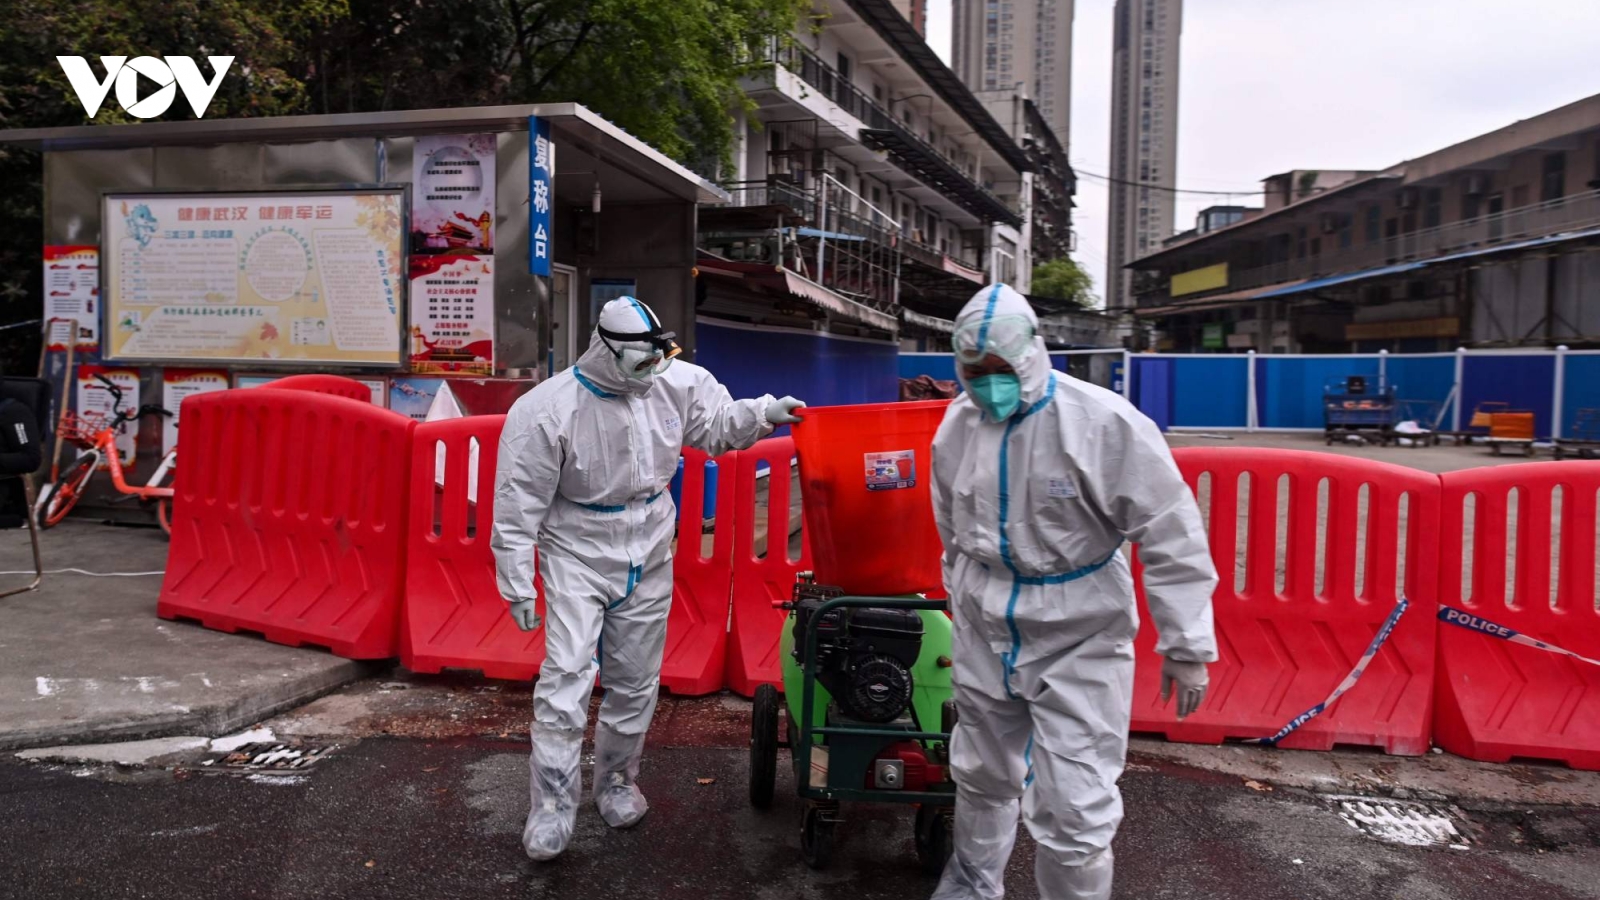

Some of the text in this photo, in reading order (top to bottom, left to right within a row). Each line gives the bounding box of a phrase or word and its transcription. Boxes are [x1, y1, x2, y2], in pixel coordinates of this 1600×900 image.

[533, 134, 549, 259] 复称台
[178, 205, 333, 220] 健康武汉 健康军运
[1446, 609, 1510, 637] POLICE
